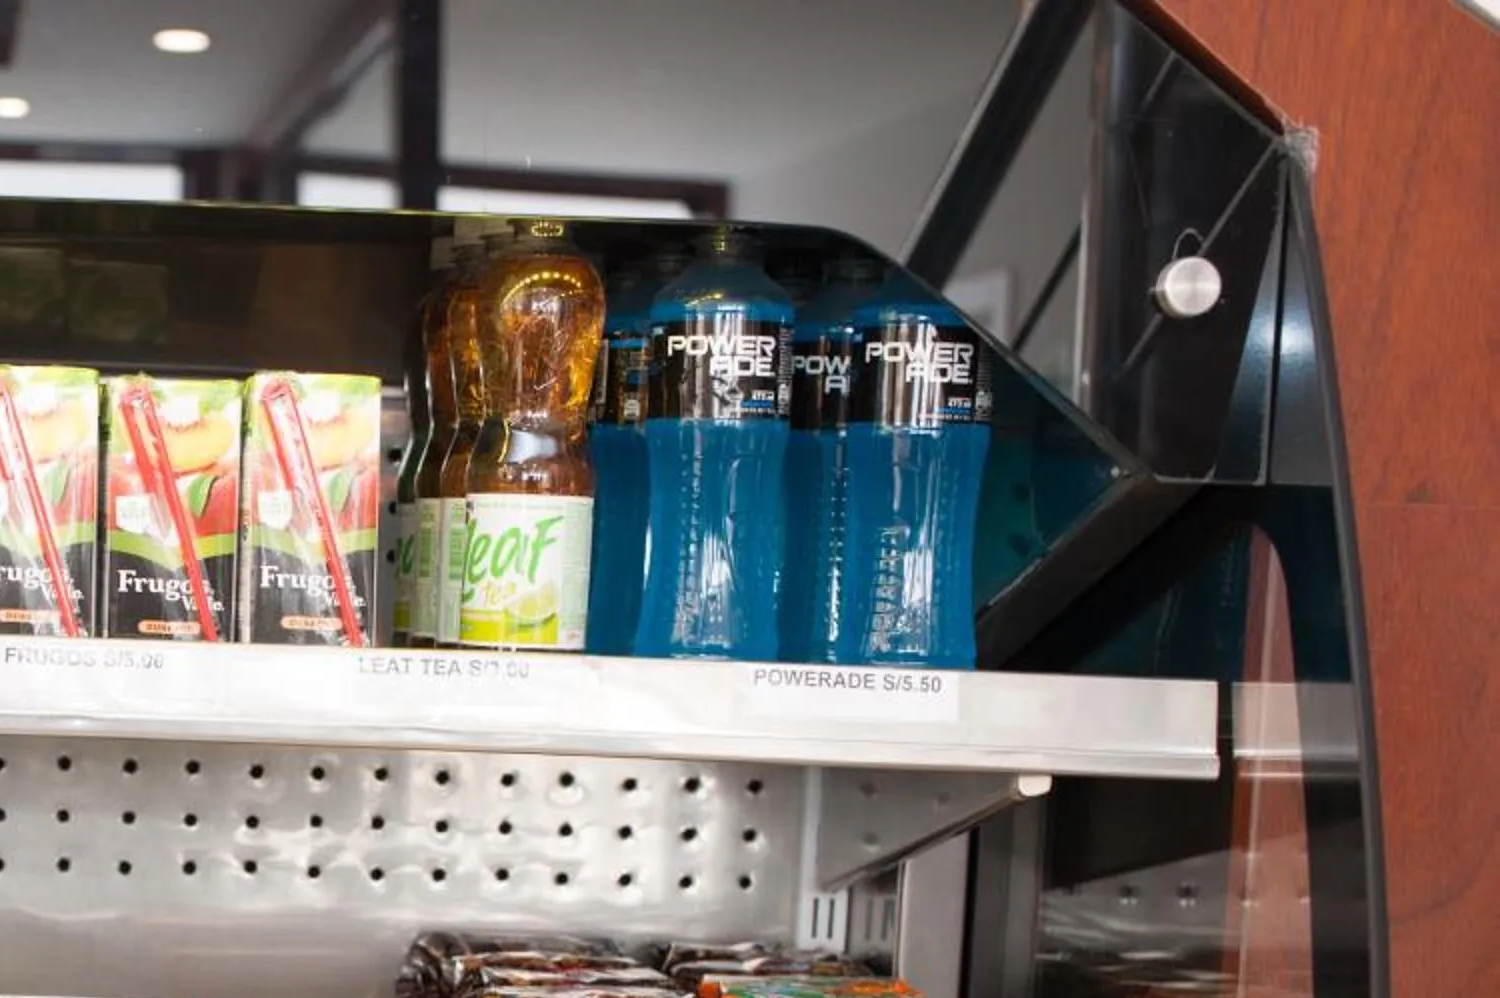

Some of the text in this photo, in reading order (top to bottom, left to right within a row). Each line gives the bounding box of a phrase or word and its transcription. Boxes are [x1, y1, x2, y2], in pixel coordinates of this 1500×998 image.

[667, 335, 776, 357] POWER
[865, 341, 974, 364] POWER
[791, 355, 850, 374] POW
[260, 565, 356, 596] Frugo
[4, 647, 97, 668] FRUGOS
[358, 656, 413, 675] LEAT
[420, 658, 462, 677] TEA
[753, 669, 943, 693] POWERADE S/5.50
